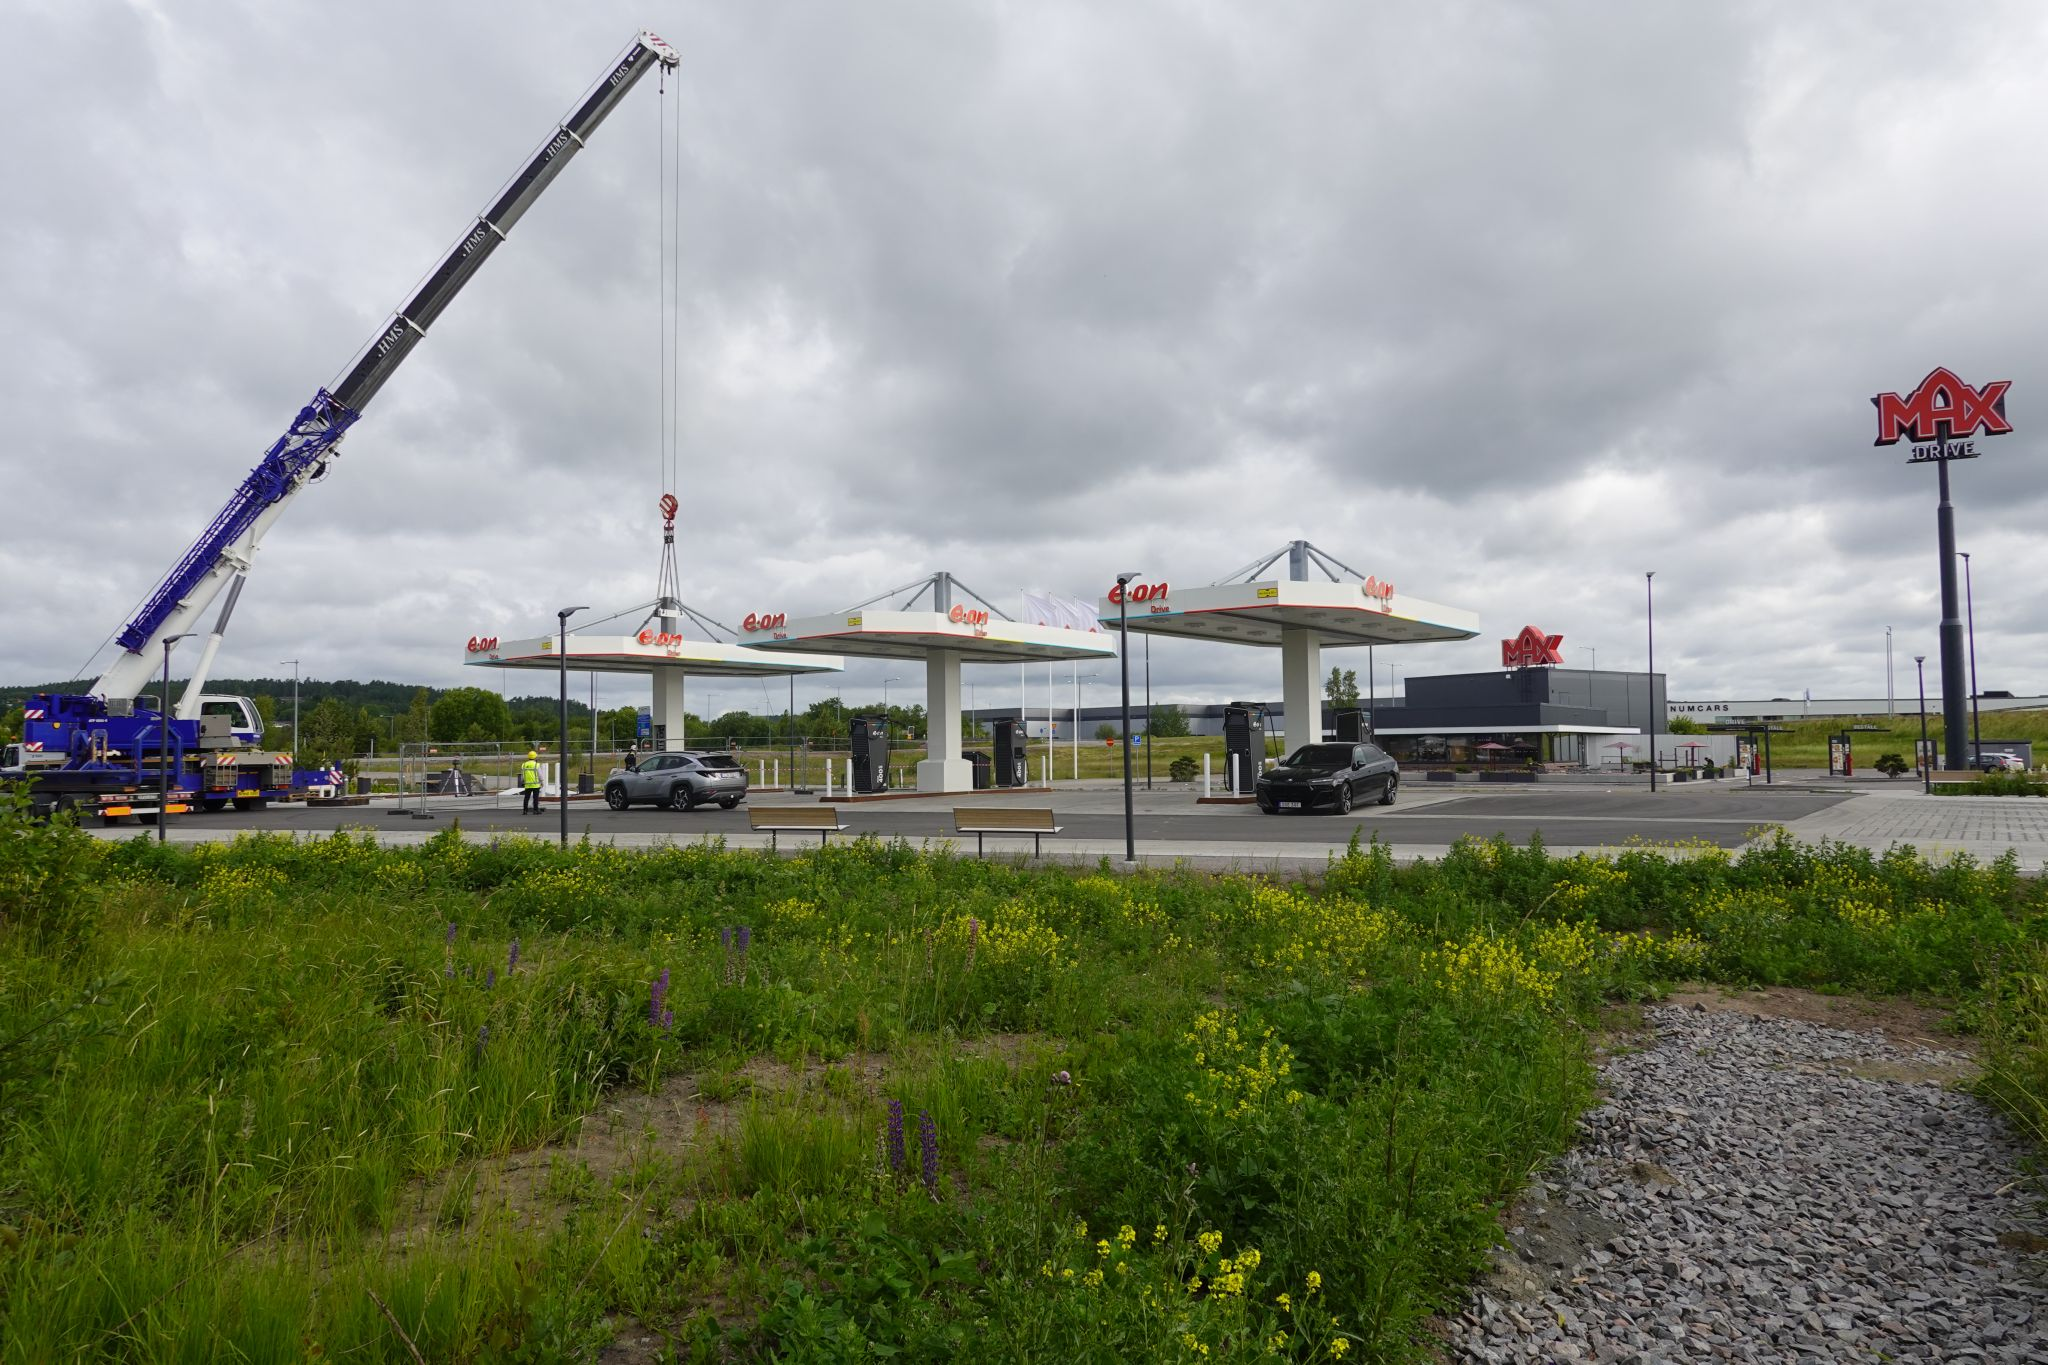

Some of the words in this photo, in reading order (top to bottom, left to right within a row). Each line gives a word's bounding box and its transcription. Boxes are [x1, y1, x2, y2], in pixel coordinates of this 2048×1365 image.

[609, 64, 629, 86] HMS
[546, 132, 569, 157] HMS
[463, 227, 486, 254] HMS
[377, 323, 404, 355] HMS
[1875, 366, 2013, 443] MAX
[1915, 442, 1975, 459] DRIVE
[1151, 605, 1170, 613] Drive
[1501, 625, 1564, 667] MAX
[1670, 704, 1729, 712] NUMCARS
